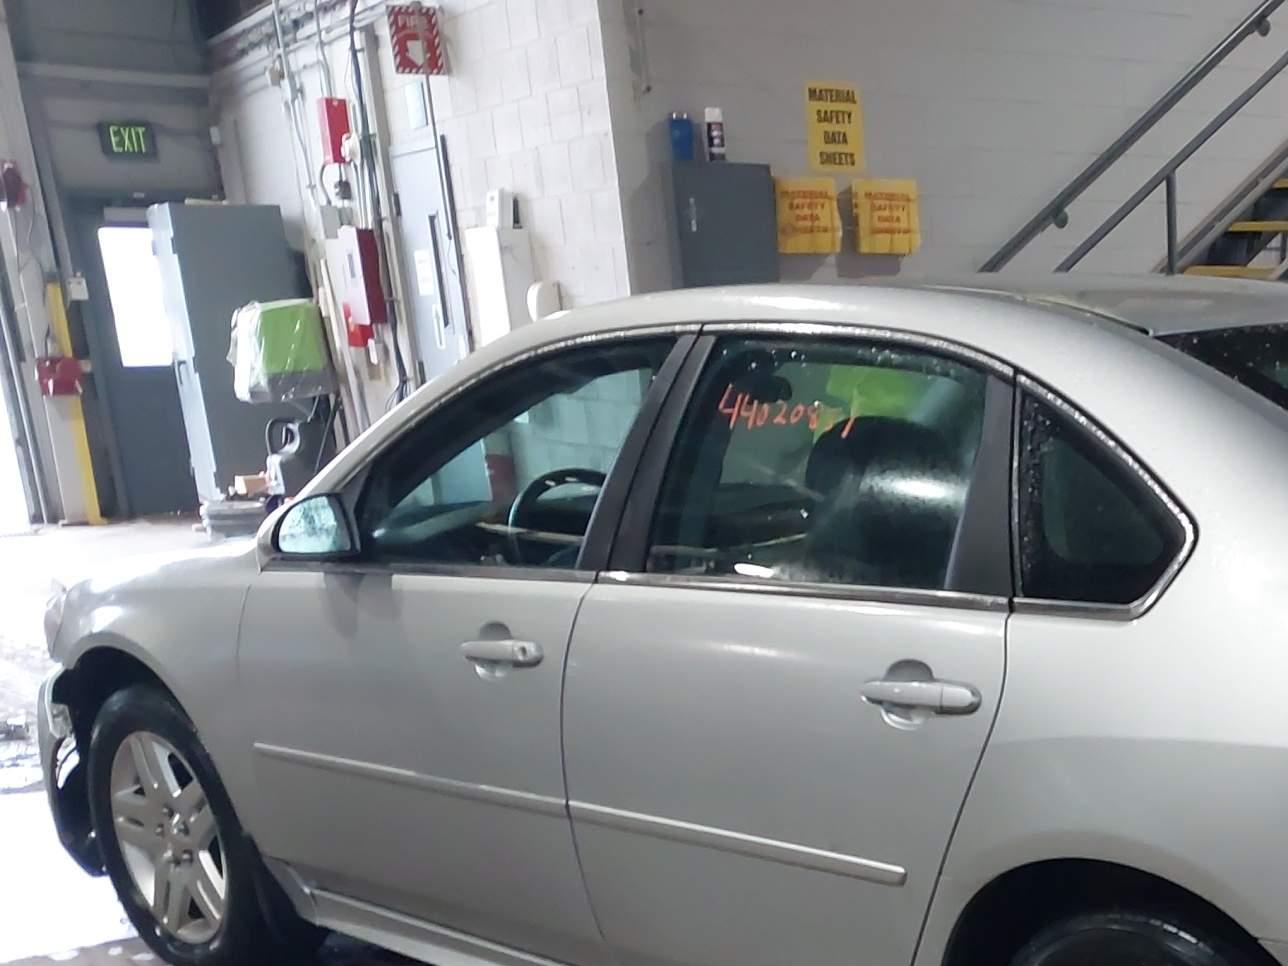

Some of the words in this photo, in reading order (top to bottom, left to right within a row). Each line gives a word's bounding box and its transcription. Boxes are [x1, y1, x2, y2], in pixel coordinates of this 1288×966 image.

[807, 87, 857, 104] MATERIAL
[816, 109, 852, 124] SAFETY
[109, 125, 146, 153] EXIT
[823, 130, 848, 145] DATA
[819, 151, 855, 167] SHEETS
